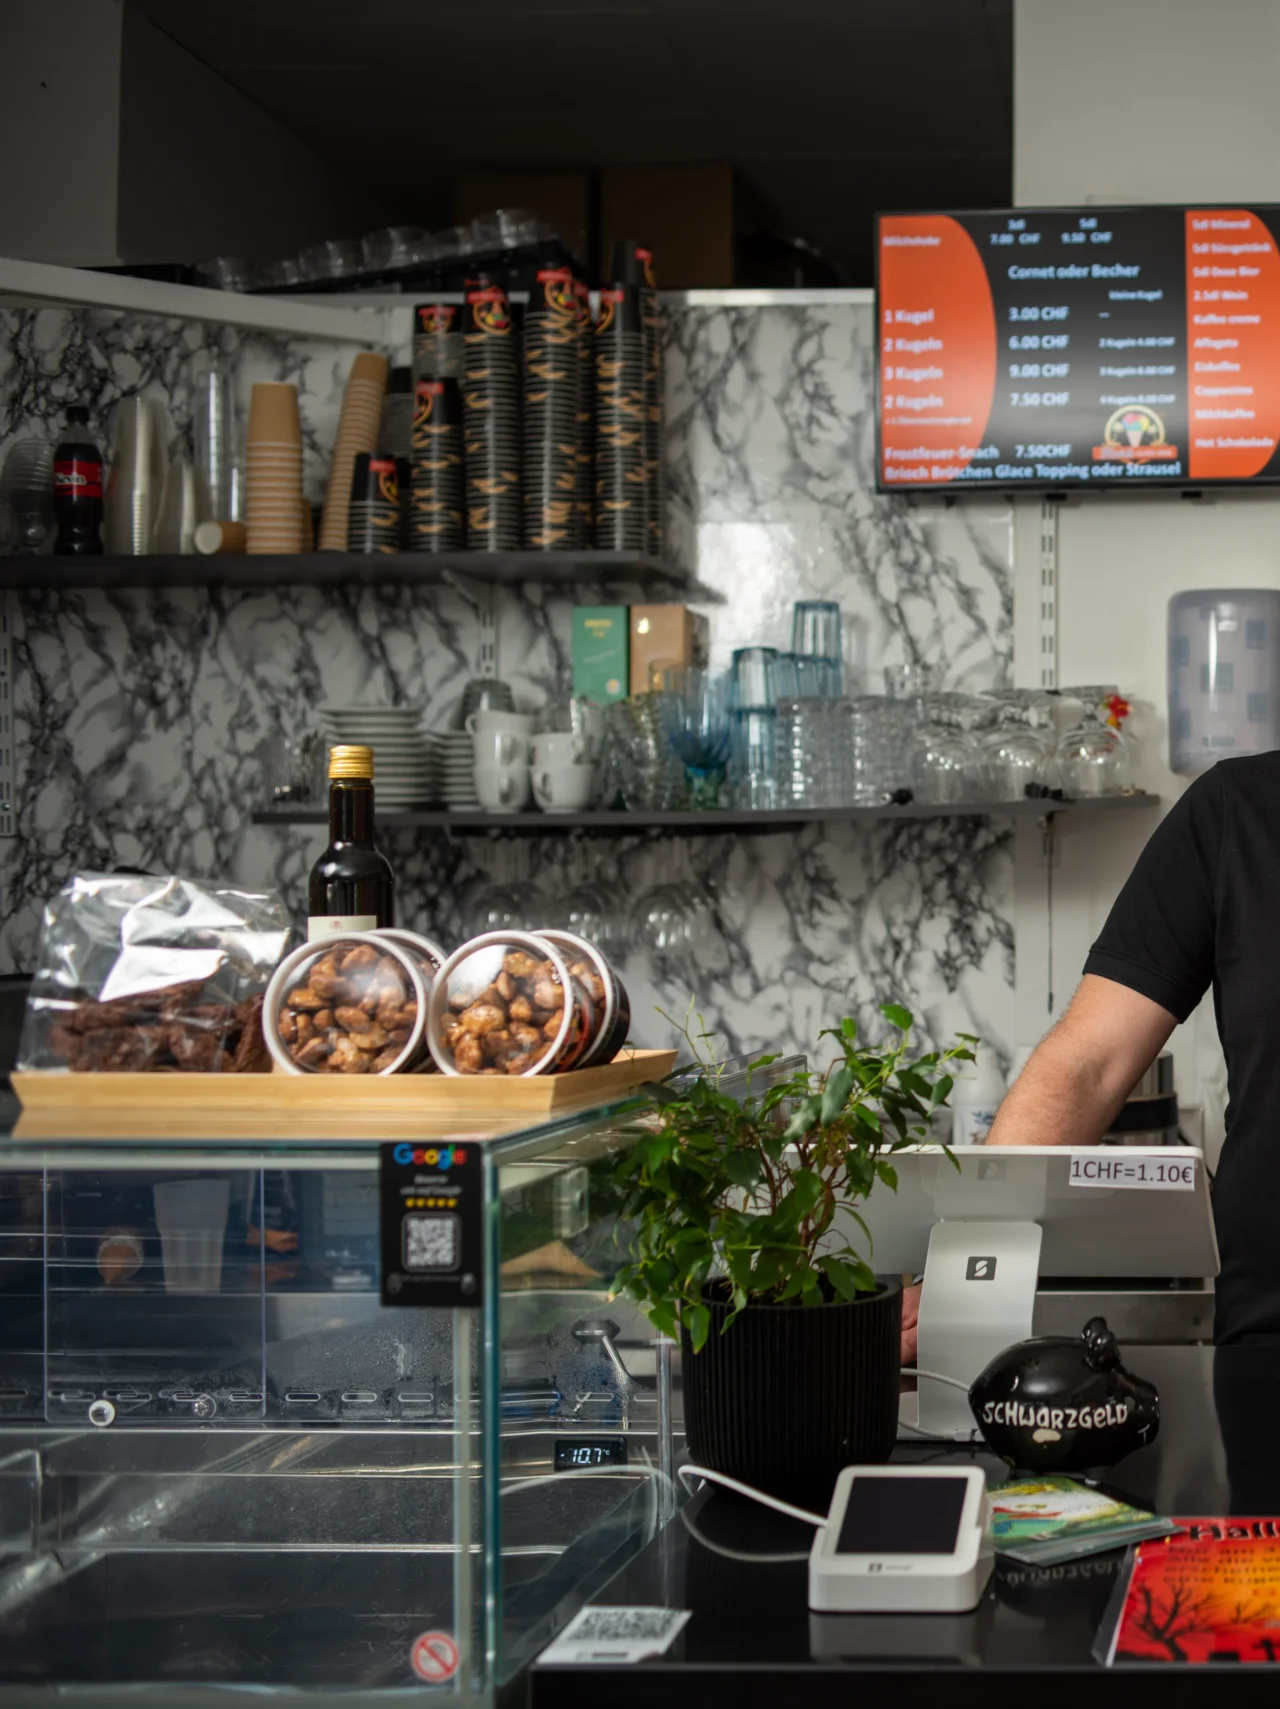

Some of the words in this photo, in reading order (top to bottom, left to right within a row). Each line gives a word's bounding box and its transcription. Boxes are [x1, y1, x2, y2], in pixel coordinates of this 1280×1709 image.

[1018, 233, 1041, 244] CHF
[1090, 232, 1112, 243] CHF
[1008, 265, 1054, 279] Cornet
[1057, 264, 1089, 278] oder
[1091, 264, 1140, 278] Becher
[884, 310, 892, 323] 1
[1041, 307, 1070, 320] CHF
[884, 338, 894, 350] 2
[1041, 336, 1070, 349] CHF
[884, 367, 893, 380] 3
[1042, 364, 1070, 378] CHF
[884, 396, 894, 408] 2
[1042, 392, 1070, 406] CHF
[995, 463, 1034, 478] Glace
[1036, 462, 1090, 480] Topping
[1091, 462, 1123, 478] oder
[393, 1143, 467, 1171] Google
[1071, 1160, 1193, 1184] 1CHF=1.10€
